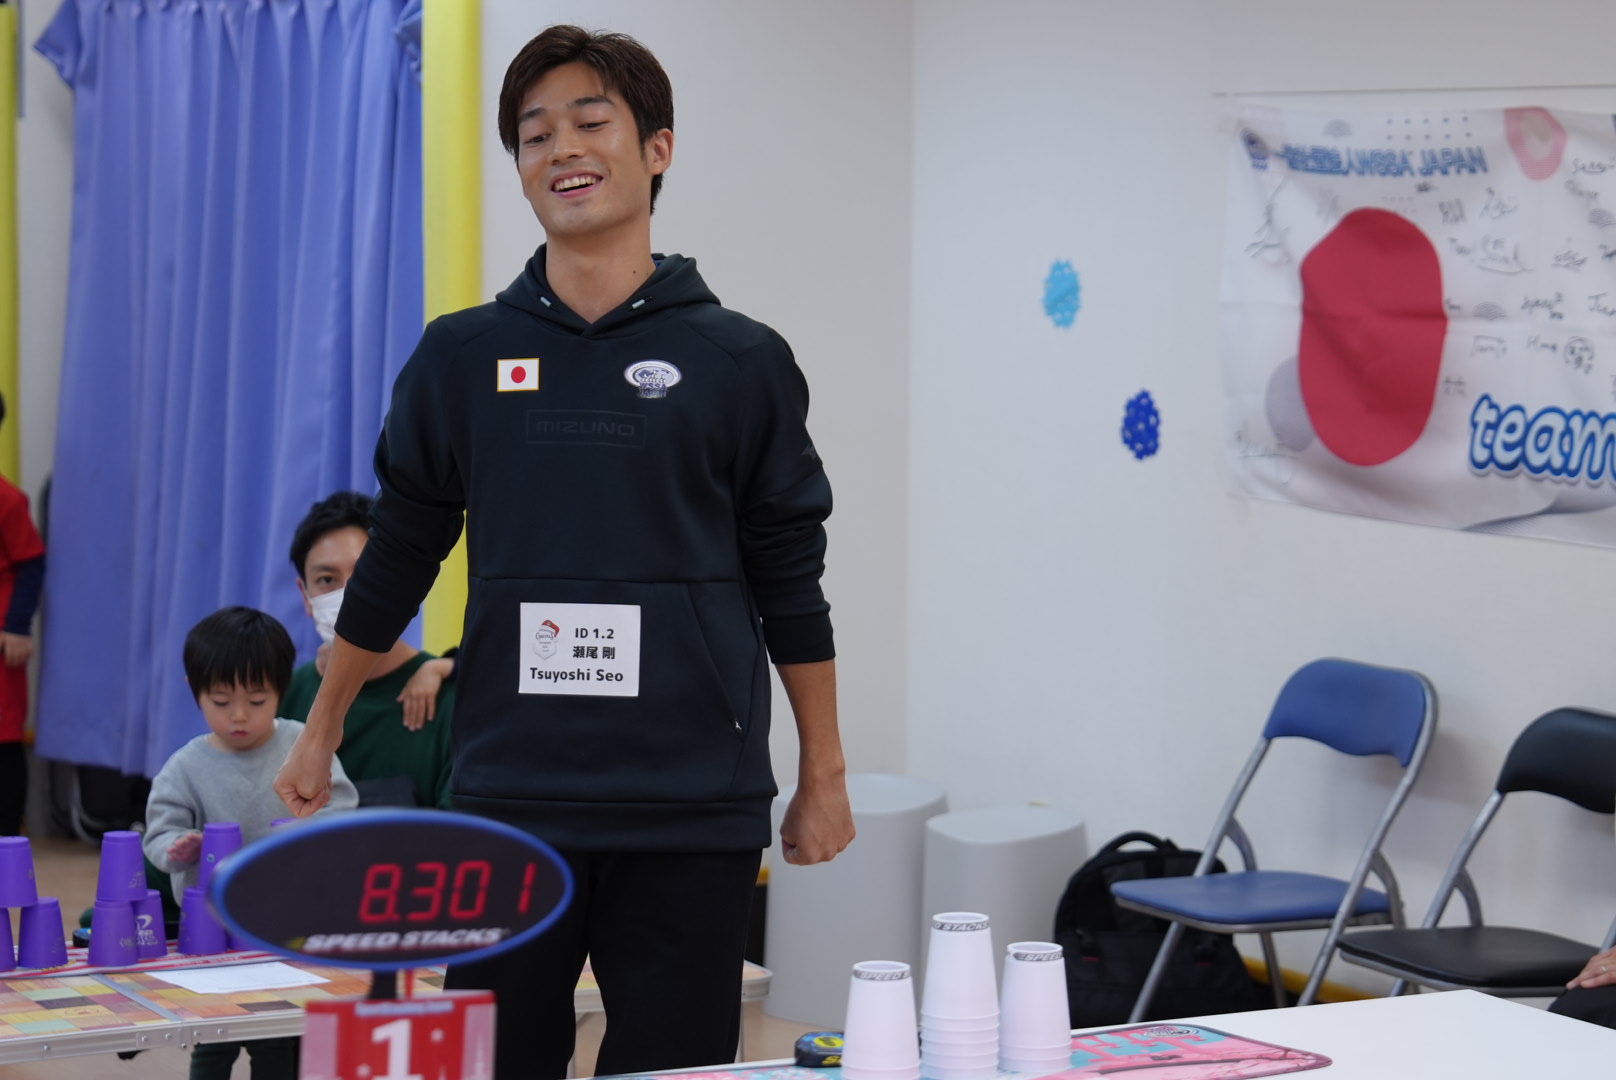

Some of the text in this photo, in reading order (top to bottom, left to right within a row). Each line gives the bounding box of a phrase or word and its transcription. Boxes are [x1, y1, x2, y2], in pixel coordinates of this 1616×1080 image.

[1418, 145, 1489, 177] JAPAN
[640, 382, 667, 391] WSSA
[536, 420, 635, 436] MIZUNO
[1470, 394, 1616, 481] team
[575, 627, 614, 639] ID 1.2
[573, 645, 615, 659] 瀬尾 剛
[530, 667, 624, 683] Tsuyoshi Seo
[942, 922, 988, 931] STACKS
[303, 927, 503, 951] SPEED STACKS
[860, 971, 902, 981] SPEED
[371, 1018, 423, 1080] 1
